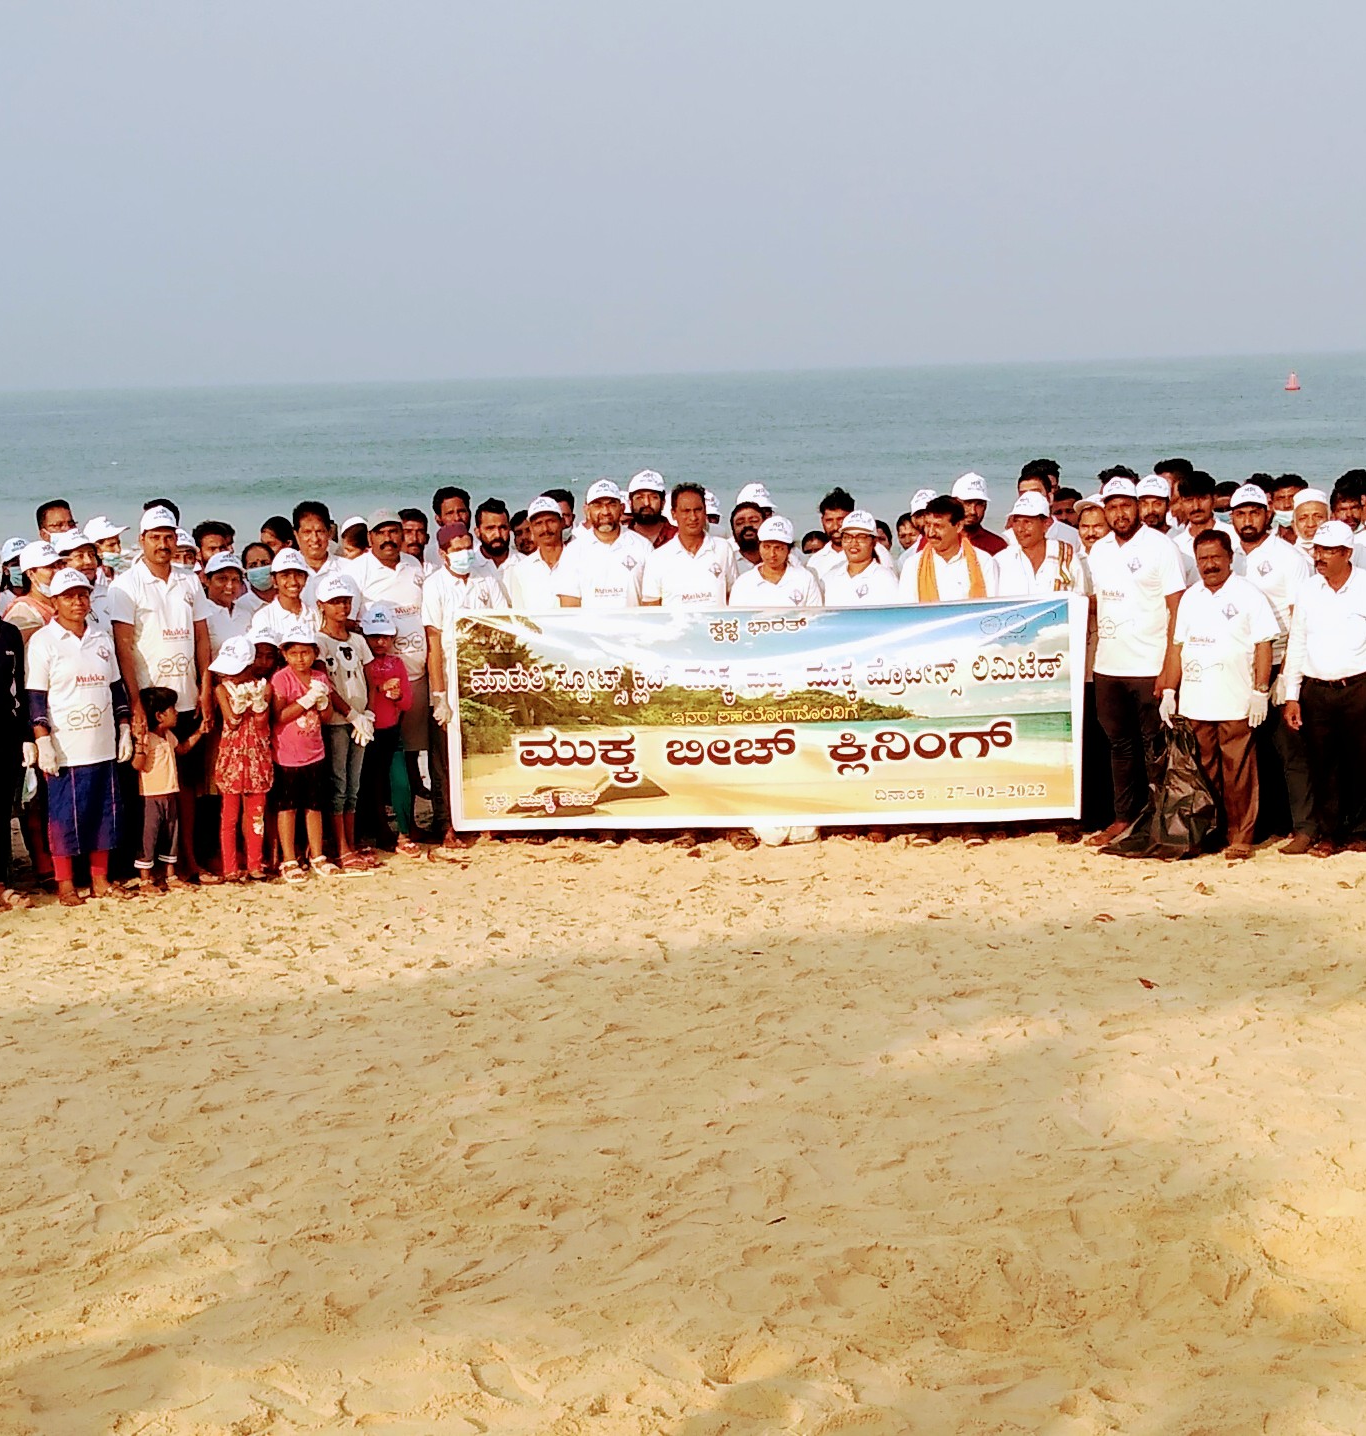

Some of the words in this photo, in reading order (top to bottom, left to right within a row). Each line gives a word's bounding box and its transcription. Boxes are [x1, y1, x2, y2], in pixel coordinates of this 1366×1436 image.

[162, 628, 190, 636] Mukka
[709, 619, 739, 643] ಸ್ವಚ್ಛ
[747, 617, 807, 635] ಭಾರತ್
[75, 673, 105, 683] Mukka
[472, 664, 545, 691] ಮಾರುತಿ
[806, 661, 857, 702] ಮುಕ್ಕ
[971, 651, 1064, 681] ಲಿಮಿಟೆಡ್
[519, 730, 639, 784] ಮುಕ್ಕ
[666, 728, 796, 766] ಬೀಚ್
[827, 720, 1013, 776] ಕ್ಲಿನಿಂಗ್
[874, 788, 926, 800] ದಿನಾಂಕ
[947, 784, 1046, 799] 27-02-2022
